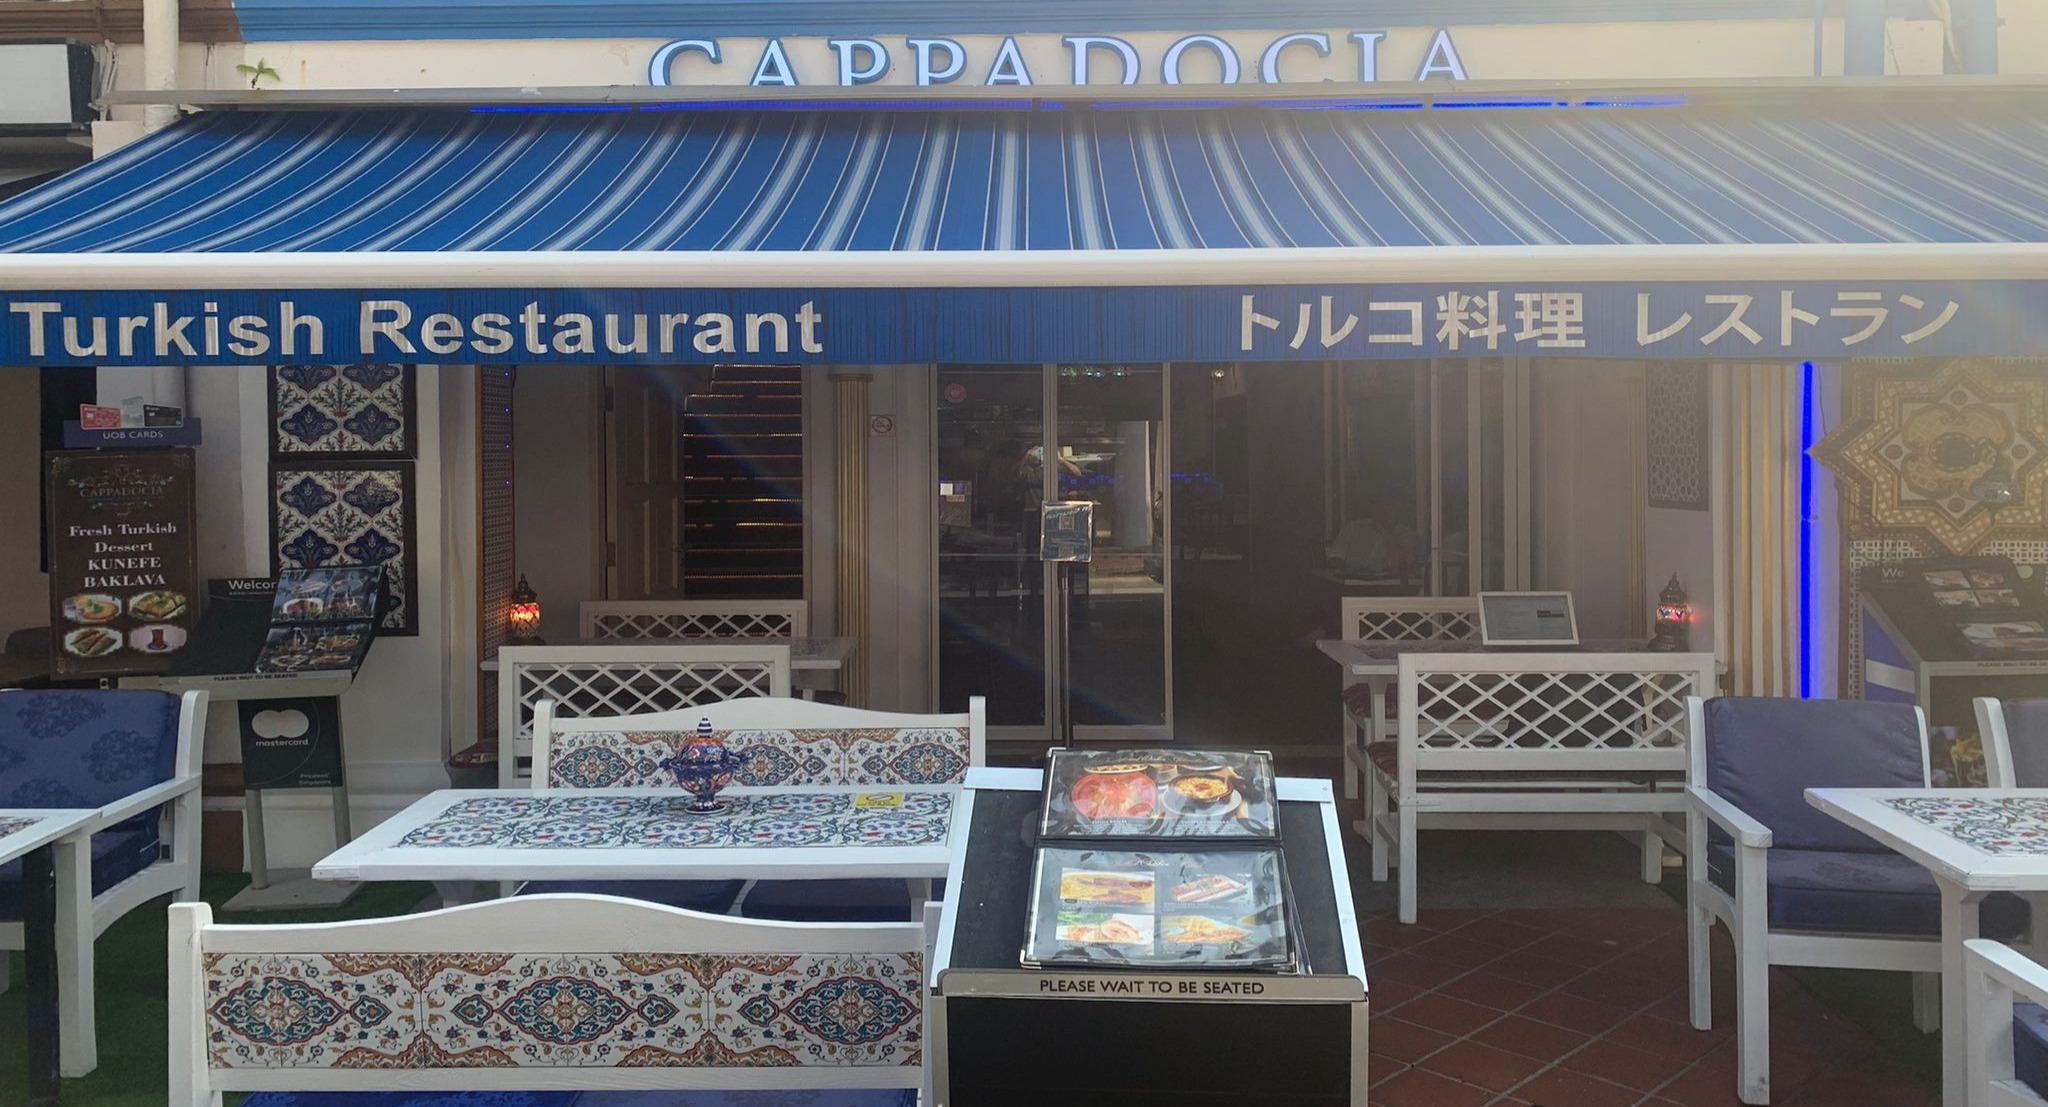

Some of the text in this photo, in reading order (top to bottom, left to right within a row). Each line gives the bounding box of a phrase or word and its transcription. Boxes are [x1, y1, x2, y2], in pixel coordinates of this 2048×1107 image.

[648, 28, 1471, 87] CAPPADOCIA
[1240, 289, 1961, 351] トルコ料理 レストラン
[8, 299, 824, 358] Turkish Restaurant
[103, 430, 164, 439] UOB CARDS
[69, 522, 177, 537] Fresh Turkish
[94, 541, 153, 553] Dessert
[88, 557, 161, 571] KUNEFE
[84, 574, 166, 588] BAKLAVA
[255, 739, 309, 747] mastercard
[1039, 979, 1265, 994] PLEASE WAIT TO BE SEATED
